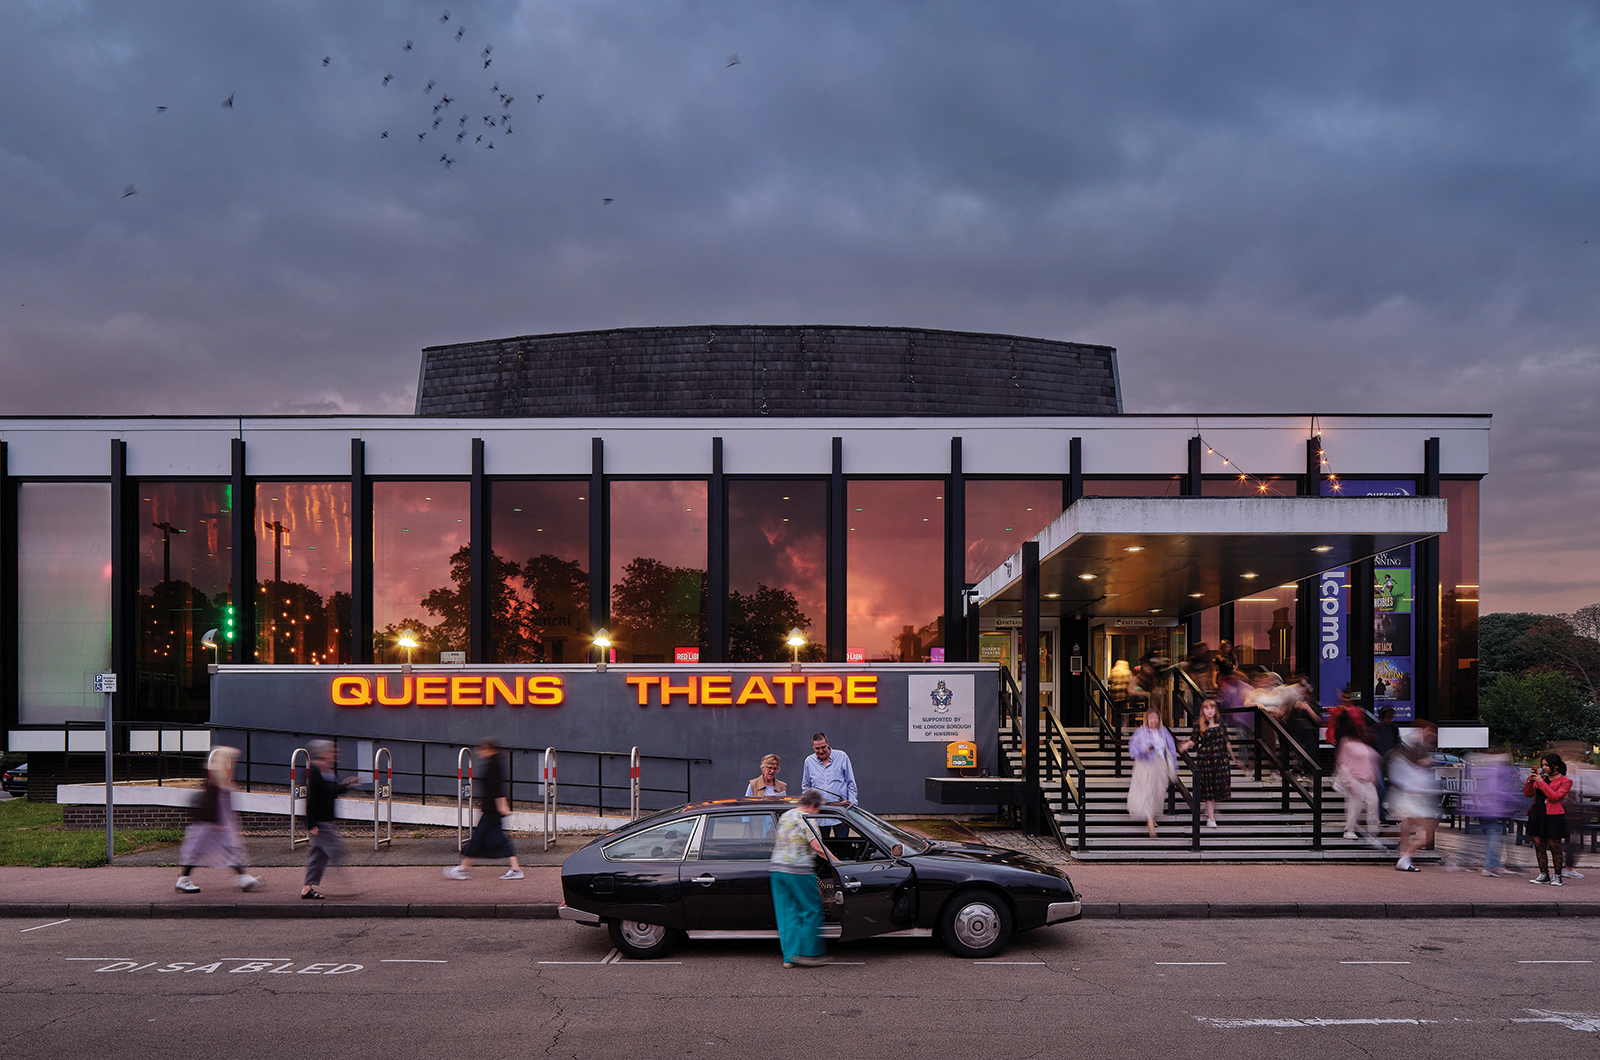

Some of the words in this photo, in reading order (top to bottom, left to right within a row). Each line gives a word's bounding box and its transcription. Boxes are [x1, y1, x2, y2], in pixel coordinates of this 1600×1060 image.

[1322, 571, 1345, 659] lcome
[331, 675, 565, 707] QUEENS
[626, 674, 879, 706] THEATRE
[94, 961, 364, 976] DISABLED
